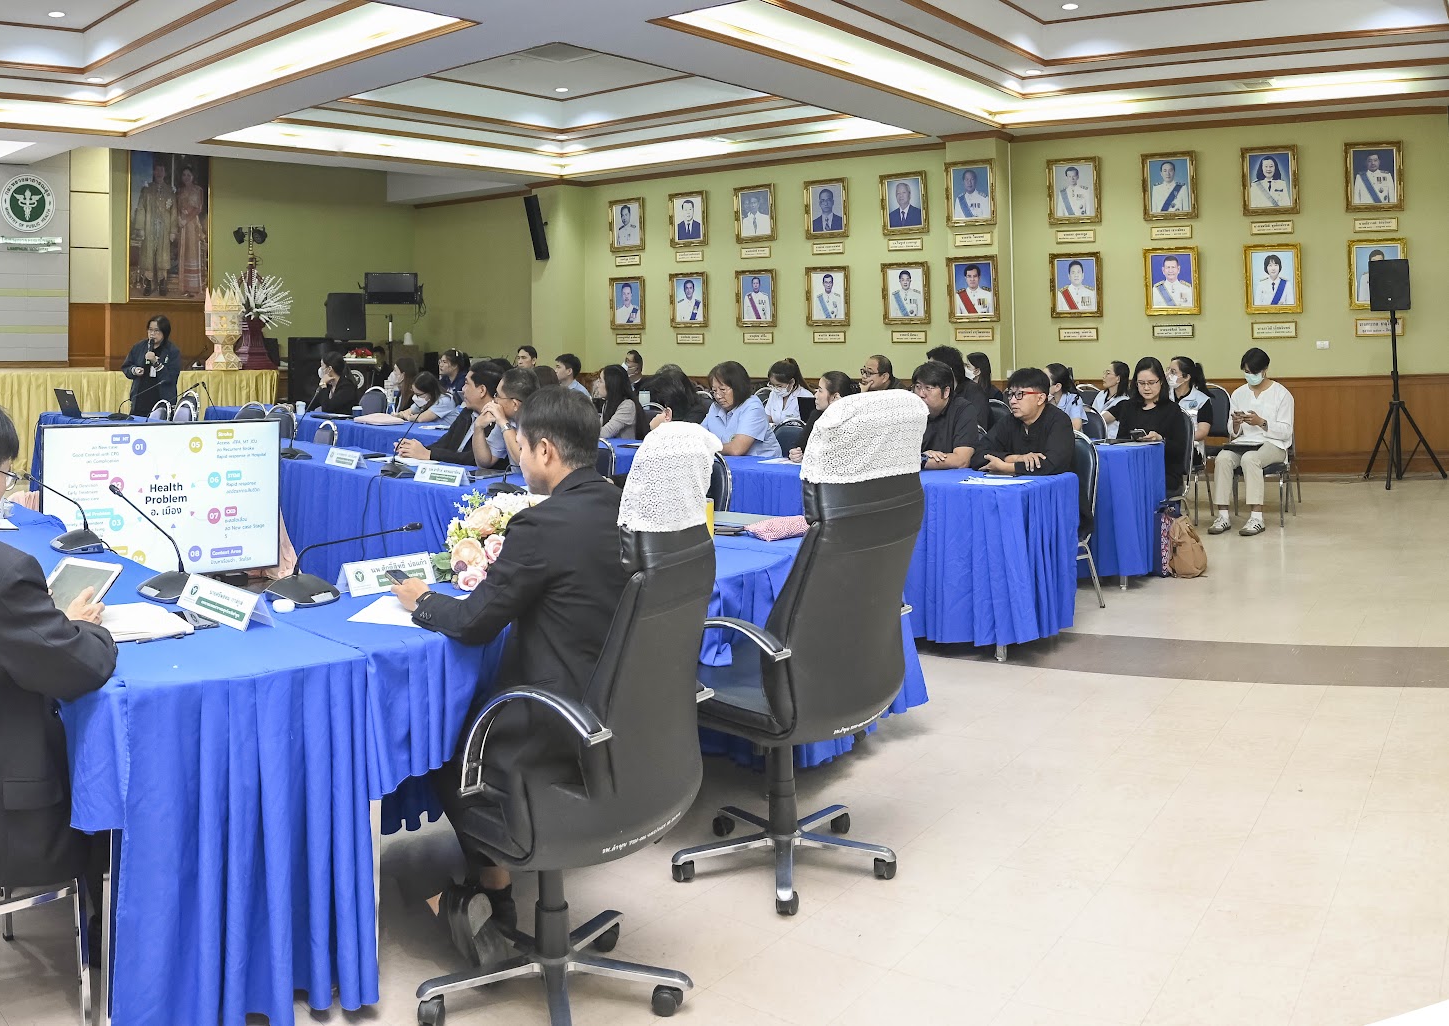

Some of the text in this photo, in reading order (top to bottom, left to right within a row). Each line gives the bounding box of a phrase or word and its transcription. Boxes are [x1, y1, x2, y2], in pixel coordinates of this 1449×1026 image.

[4, 207, 18, 225] MINISTRY
[26, 221, 41, 229] PUBLIC
[41, 208, 51, 223] HEALTH
[191, 441, 201, 449] 05
[209, 476, 220, 484] 06
[150, 482, 183, 493] Health
[145, 494, 188, 505] Problem
[162, 505, 182, 516] เมือง
[209, 512, 219, 520] 07
[190, 550, 200, 558] 08
